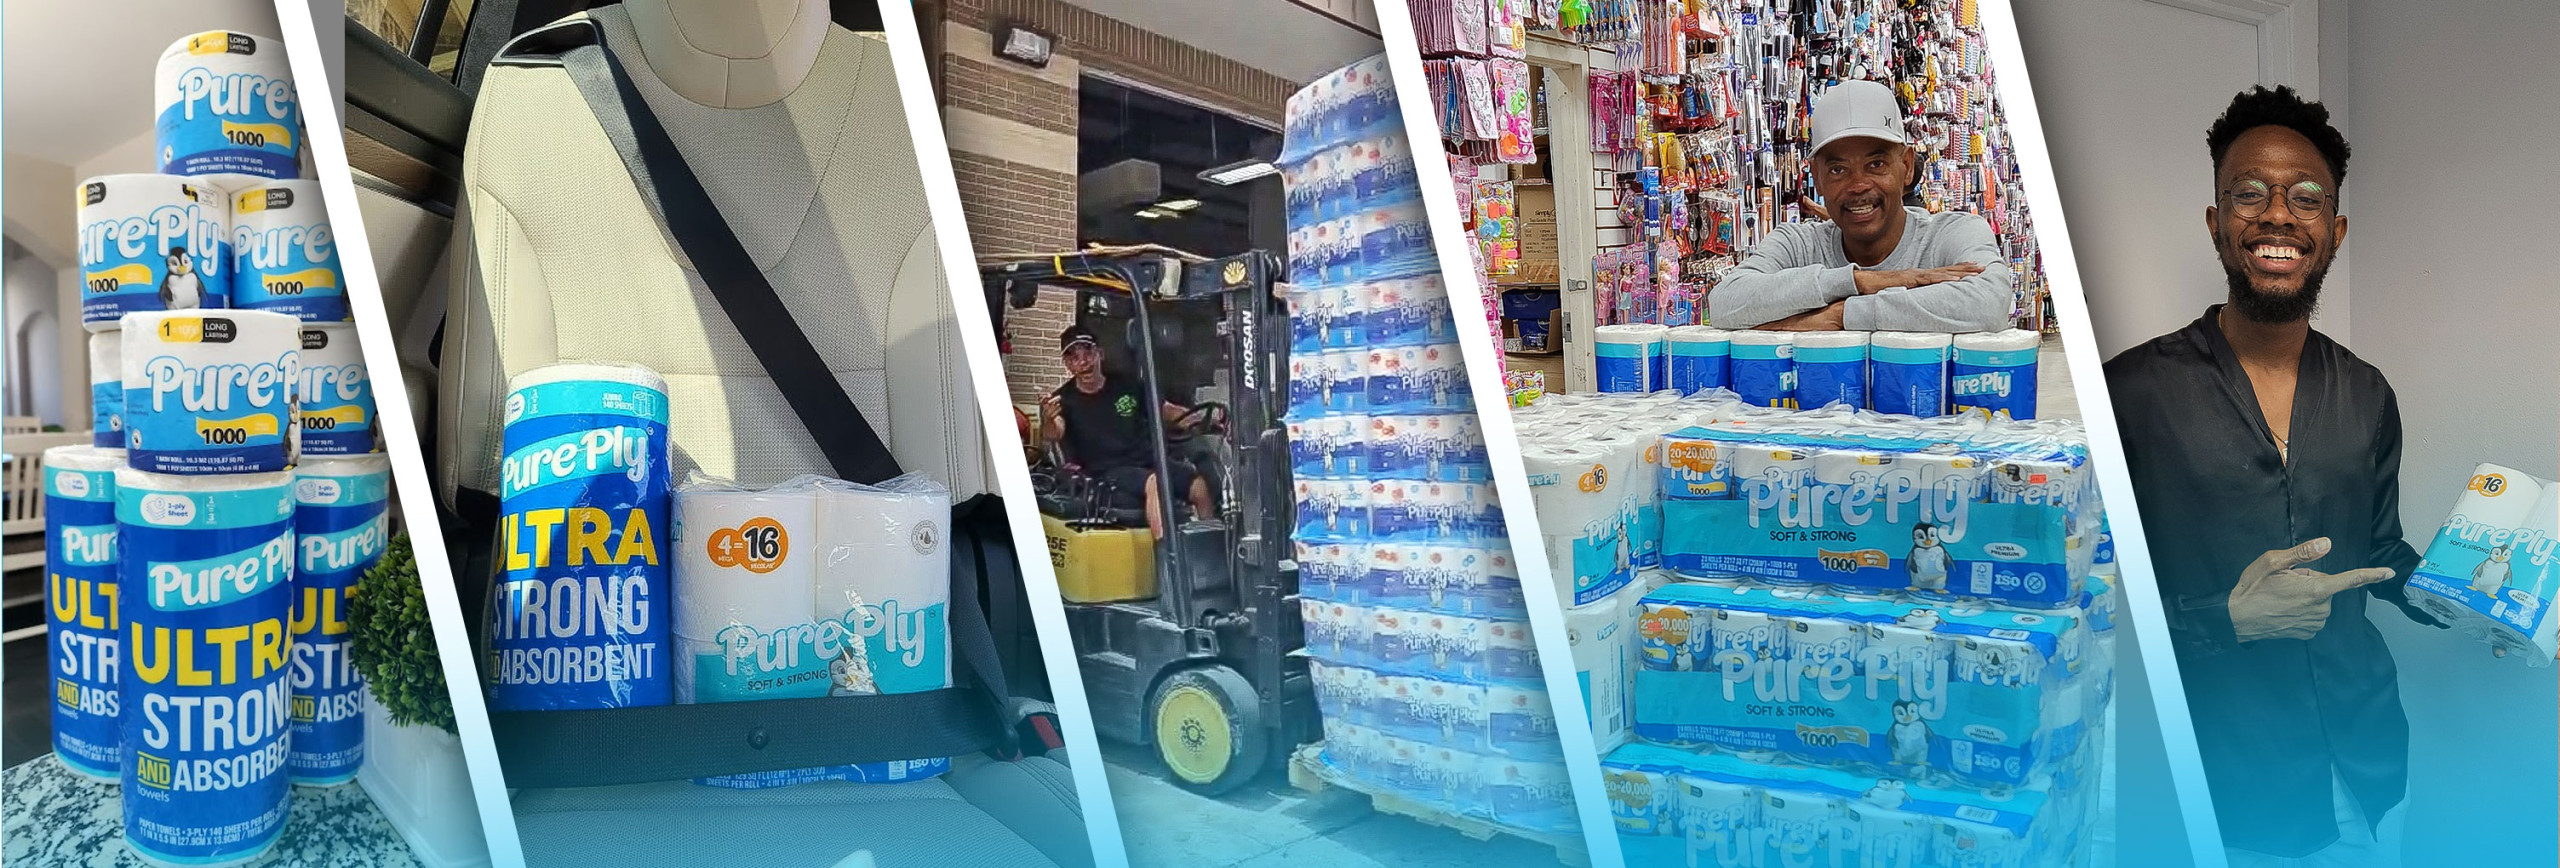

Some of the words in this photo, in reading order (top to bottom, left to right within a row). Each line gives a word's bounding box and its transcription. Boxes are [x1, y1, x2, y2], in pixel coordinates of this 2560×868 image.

[229, 36, 249, 45] LONG
[178, 66, 290, 121] Pure
[227, 130, 265, 147] 1000
[268, 192, 286, 200] LONG
[80, 216, 149, 267] ure
[149, 204, 219, 277] Ply
[232, 224, 333, 274] Pure
[88, 278, 118, 293] 1000
[266, 281, 304, 296] 1000
[164, 321, 170, 336] 1
[1243, 310, 1255, 389] DOOSAN
[145, 355, 277, 413] Pure
[299, 364, 363, 404] re
[1953, 376, 1979, 395] ure
[1979, 372, 2011, 397] Ply
[301, 417, 336, 430] 1000
[202, 427, 247, 445] 1000
[502, 442, 578, 499] Pure
[580, 426, 646, 482] Ply
[1528, 475, 1542, 485] ure
[1544, 474, 1560, 486] Ply
[1740, 476, 1875, 529] Pure
[1876, 463, 1969, 543] Ply
[2001, 483, 2042, 506] ure
[1585, 511, 1620, 546] Pure
[1621, 494, 1639, 525] Ply
[62, 527, 117, 562] Pur
[1770, 531, 1796, 541] SOFT
[1799, 531, 1807, 541] &
[1810, 531, 1857, 542] STRONG
[1995, 544, 2015, 552] ULTRA
[2445, 513, 2511, 546] Pure
[2510, 527, 2558, 566] Ply
[2449, 540, 2461, 548] SOFT
[2467, 544, 2490, 555] STRONG
[301, 526, 375, 572] Pure
[150, 557, 259, 607] Pure
[262, 529, 296, 582] Ply
[1822, 556, 1858, 572] 1000
[1995, 574, 2021, 586] ISO
[52, 573, 118, 631] ULT
[493, 576, 649, 640] STRONG
[715, 619, 844, 676] Pure
[844, 599, 925, 667] Ply
[1712, 628, 1747, 650] ure
[1748, 623, 1787, 656] Ply
[59, 629, 119, 684] STR
[500, 643, 656, 685] ABSORBENT
[1790, 641, 1828, 664] ure
[292, 640, 361, 689] STR
[748, 679, 772, 691] SOFT
[776, 678, 784, 687] &
[787, 669, 828, 684] STRONG
[1713, 650, 1852, 702] Pure
[1862, 647, 1949, 720] Ply
[57, 681, 79, 705] AND
[79, 686, 120, 717] ABS
[292, 699, 315, 719] ND
[316, 687, 365, 723] ABSO
[1746, 705, 1773, 716] SOFT
[1776, 705, 1784, 716] &
[1788, 705, 1835, 718] STRONG
[291, 723, 313, 733] wels
[1800, 732, 1838, 748] 1000
[137, 756, 170, 785] AND
[173, 729, 290, 792] ABSORBEN
[301, 753, 322, 761] TOWELS
[909, 759, 929, 769] ISO
[1974, 754, 2001, 768] ISO
[137, 784, 170, 802] towels
[706, 777, 730, 787] SHEETS
[731, 780, 744, 789] PER
[157, 823, 181, 836] TOWELS
[187, 828, 208, 837] 3-PLY
[210, 827, 222, 836] 140
[224, 820, 250, 835] SHEETS
[251, 815, 262, 828] PER
[207, 837, 212, 845] X
